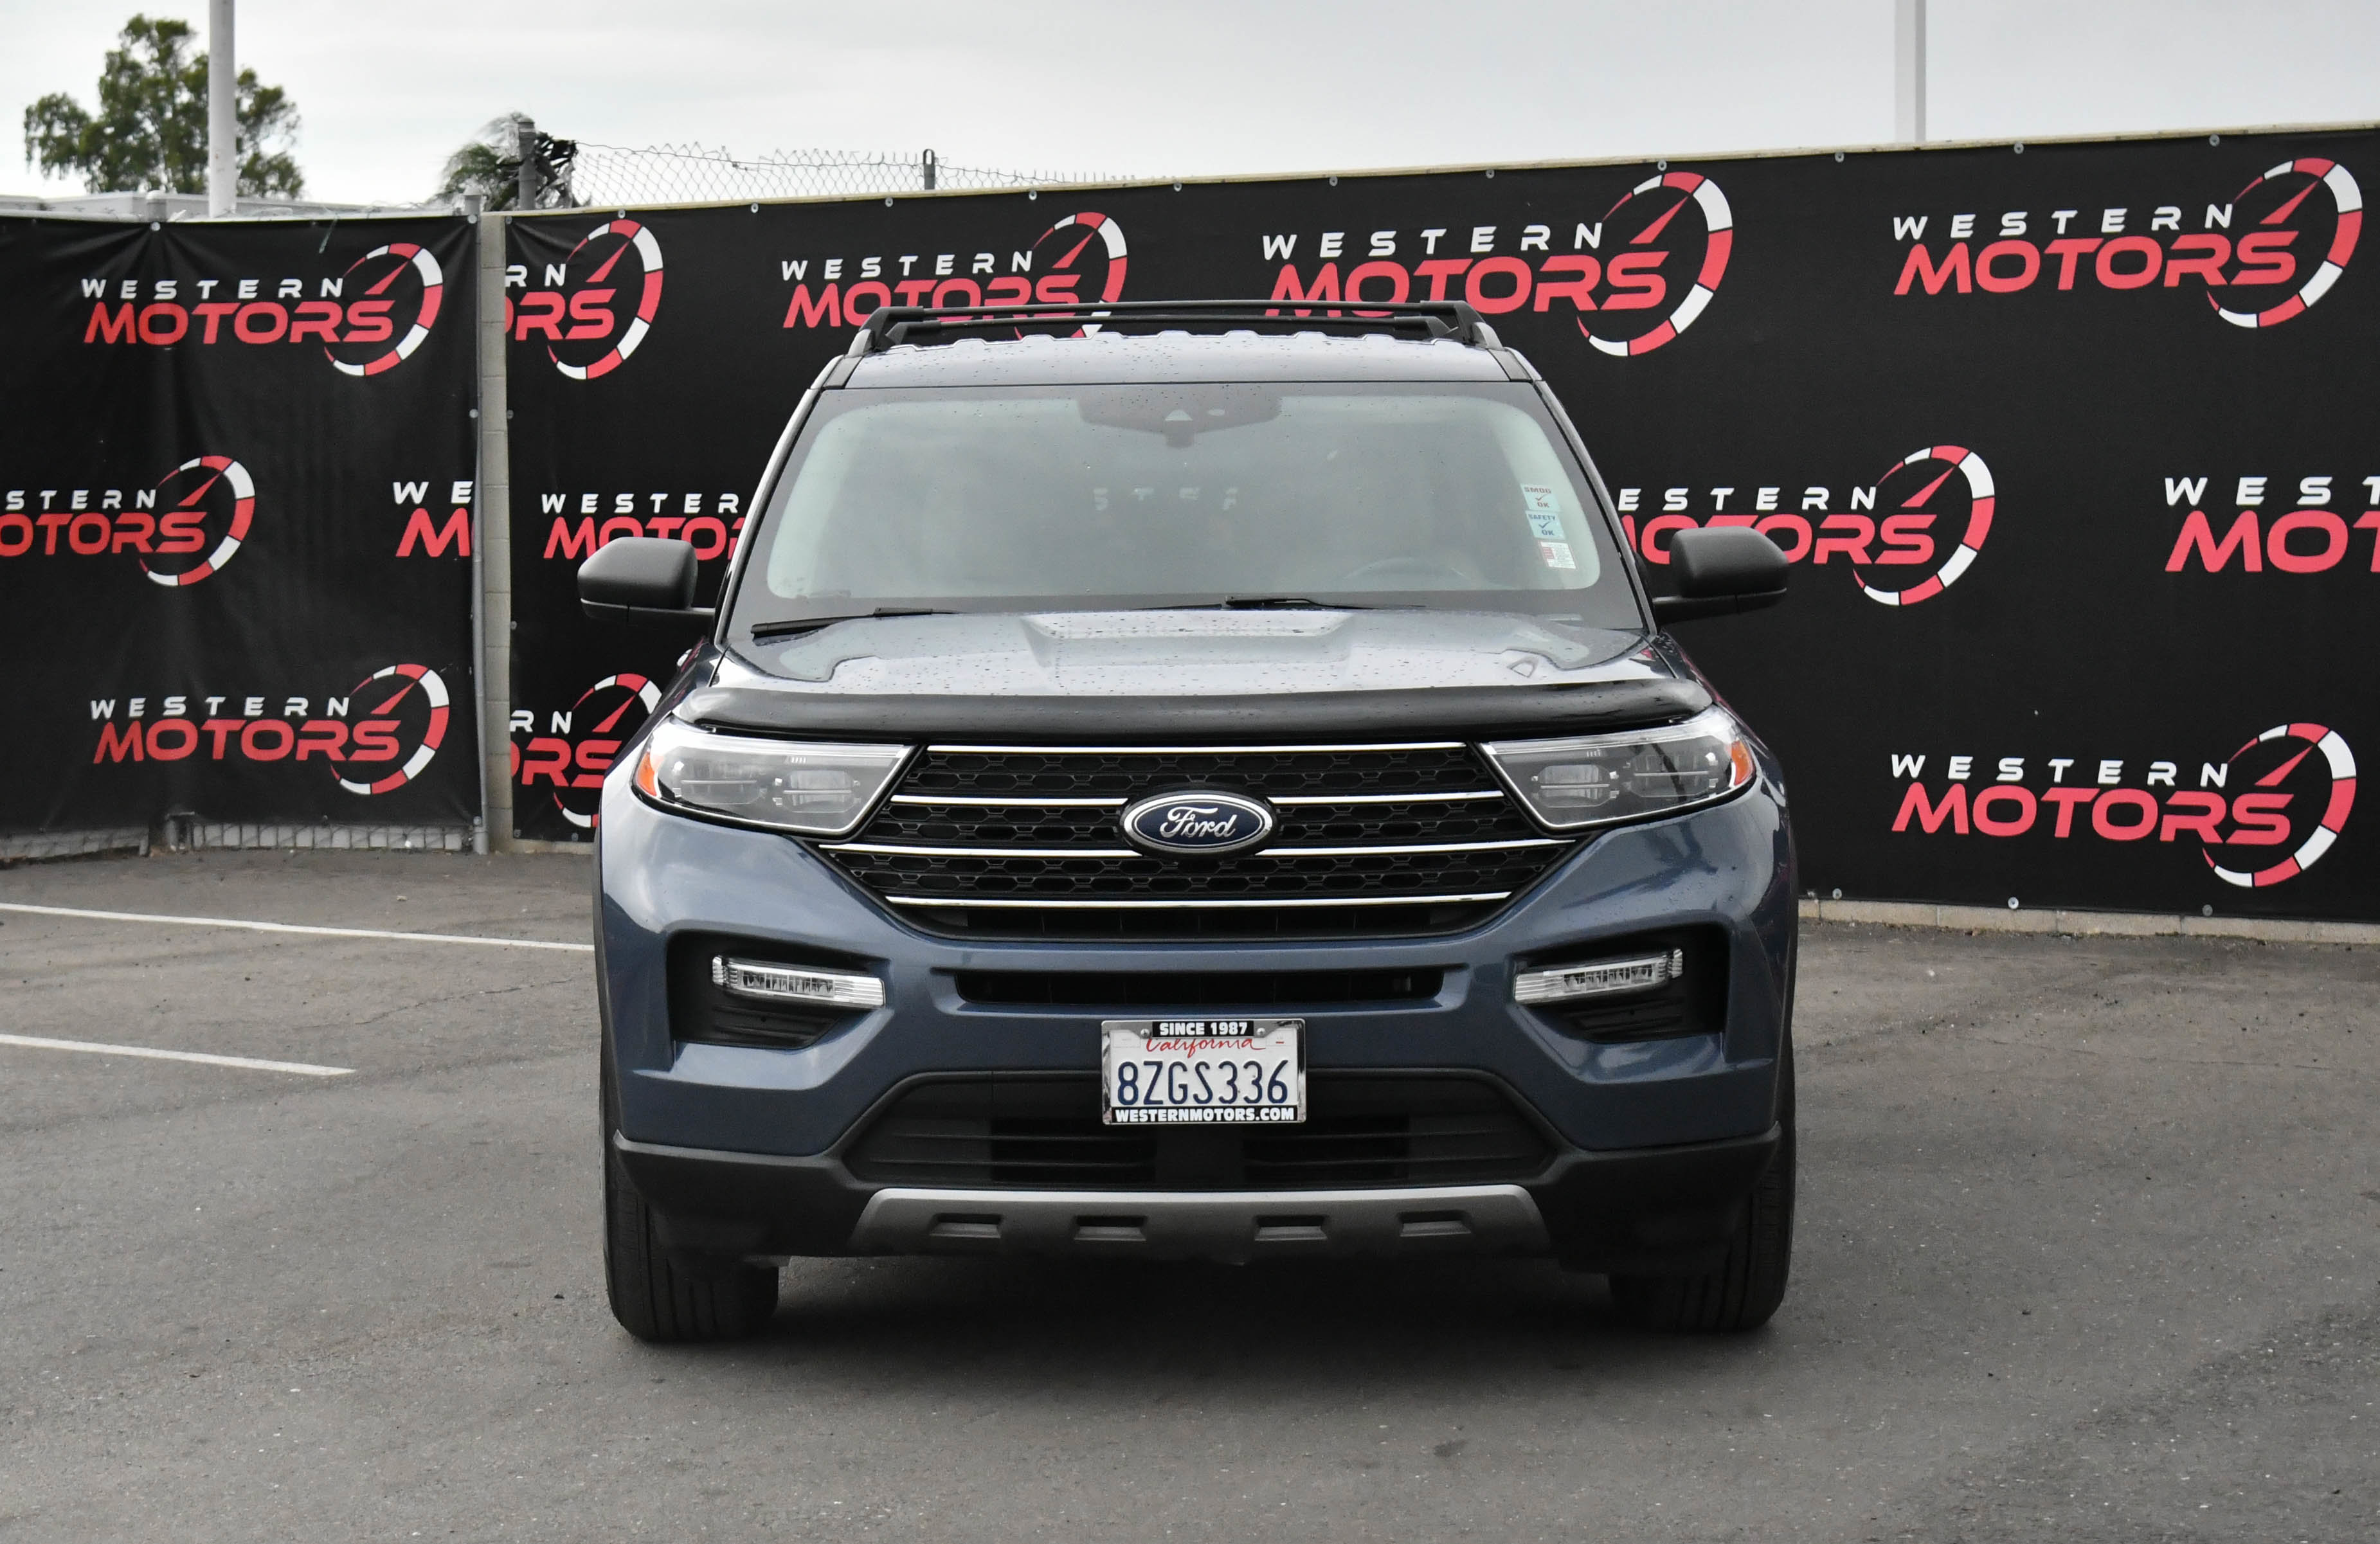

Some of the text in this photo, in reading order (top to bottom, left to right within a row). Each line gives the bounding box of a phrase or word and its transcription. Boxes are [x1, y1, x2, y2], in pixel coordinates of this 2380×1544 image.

[1894, 204, 2233, 240] WESTERN
[1263, 223, 1602, 260] WESTERN
[782, 251, 1032, 281] WESTERN
[1894, 231, 2298, 295] MOTORS
[82, 278, 343, 299] WESTERN
[783, 274, 1081, 328] MOTORS
[1265, 251, 1669, 317] MOTORS
[84, 300, 395, 345] MOTORS
[505, 289, 617, 341] RS
[541, 493, 739, 513] WESTER
[1618, 487, 1877, 511] ESTERN
[0, 512, 207, 557] OTORS
[91, 696, 350, 719] WESTERN
[94, 719, 401, 764] MOTORS
[510, 737, 622, 789] RS
[1892, 754, 2228, 788] WESTERN
[1159, 806, 1238, 838] Ford
[1892, 782, 2294, 846] MOTORS
[1160, 1022, 1248, 1036] SINCE 1987
[1146, 1038, 1266, 1059] California
[1117, 1059, 1288, 1105] 8ZGS336
[1116, 1108, 1294, 1122] WESTERNMOTORS.COM
